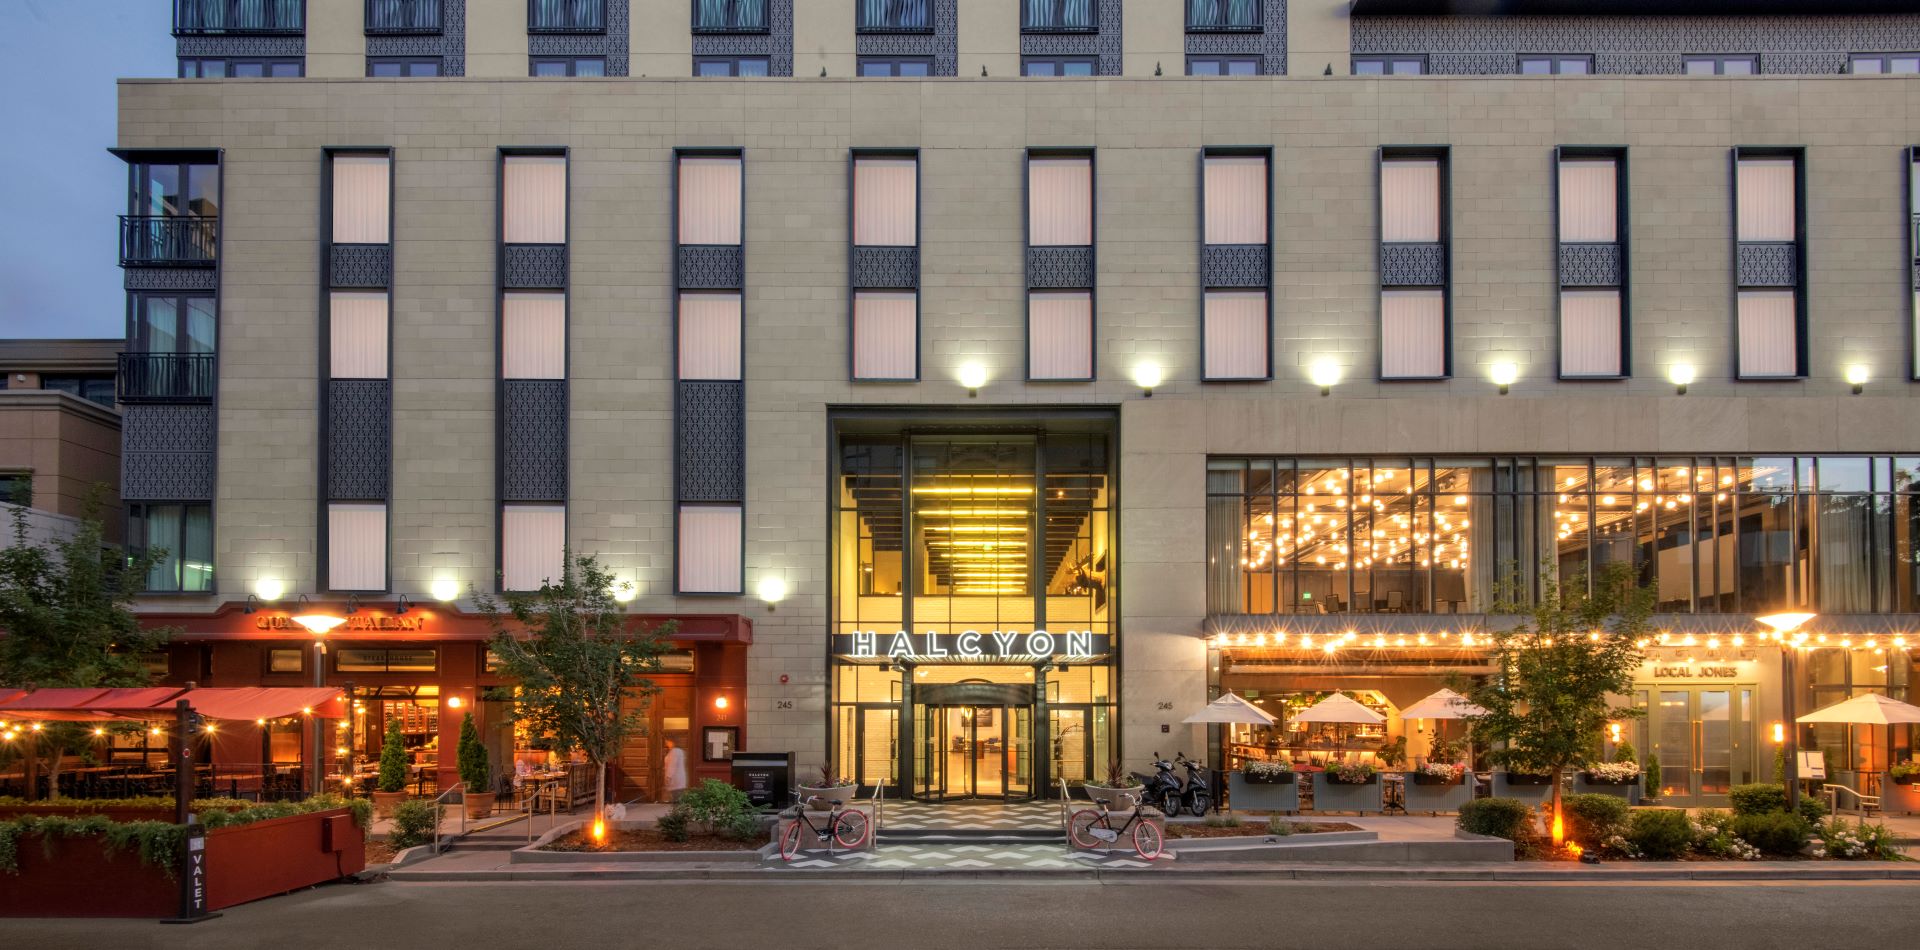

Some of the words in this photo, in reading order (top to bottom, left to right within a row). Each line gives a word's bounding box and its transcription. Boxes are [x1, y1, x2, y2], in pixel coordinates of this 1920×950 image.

[852, 630, 1092, 658] HALCYON
[1654, 666, 1693, 678] LOCAL
[1698, 666, 1738, 678] JONES
[777, 701, 793, 709] 245
[1157, 701, 1174, 710] 245
[193, 854, 203, 909] VALET
